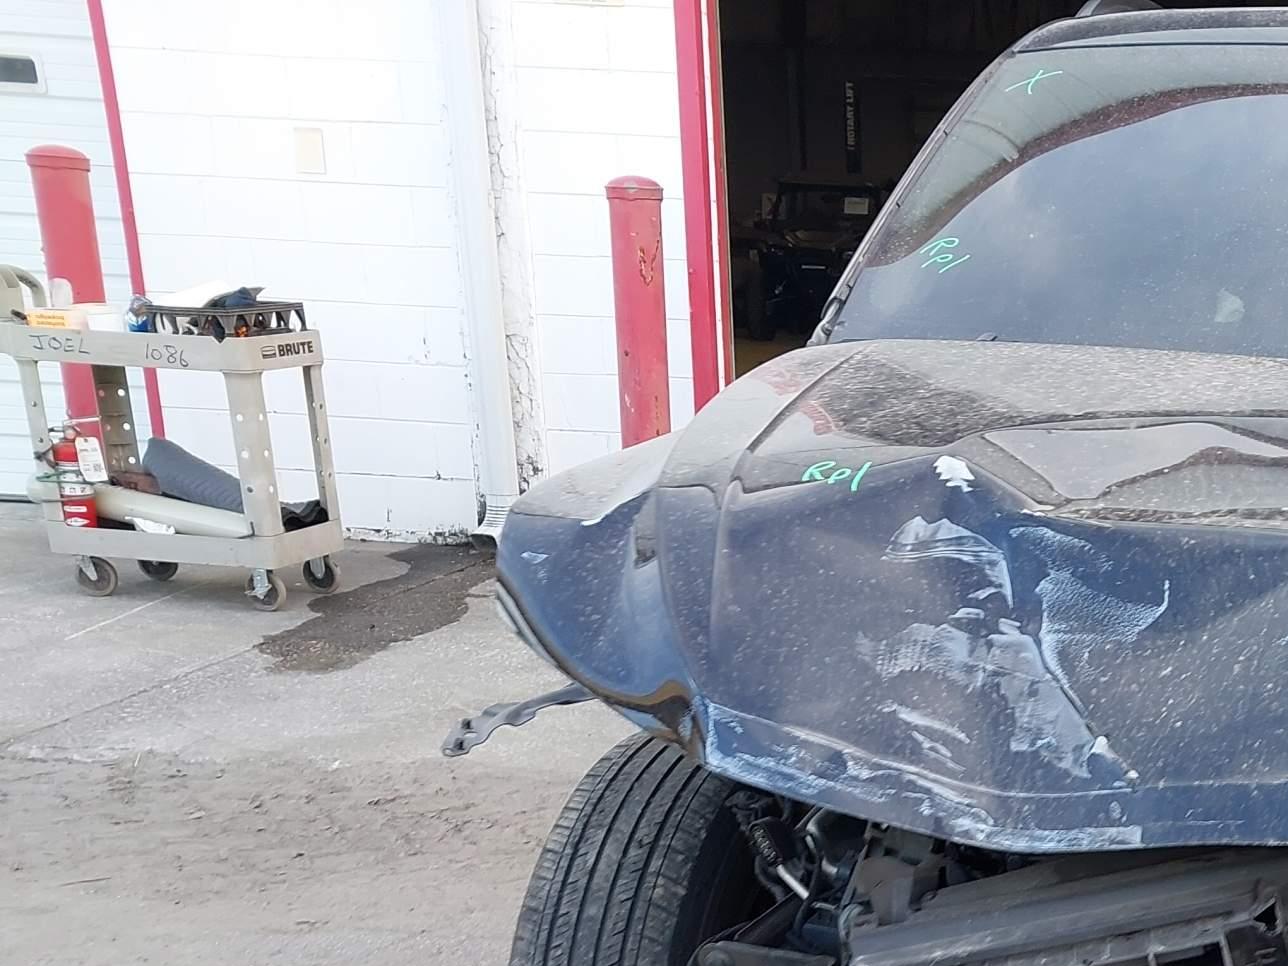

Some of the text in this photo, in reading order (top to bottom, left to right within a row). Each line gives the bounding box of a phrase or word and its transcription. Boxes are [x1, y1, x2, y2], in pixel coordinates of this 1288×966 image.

[28, 334, 190, 368] JOEL 1086
[277, 340, 315, 357] BRUTE
